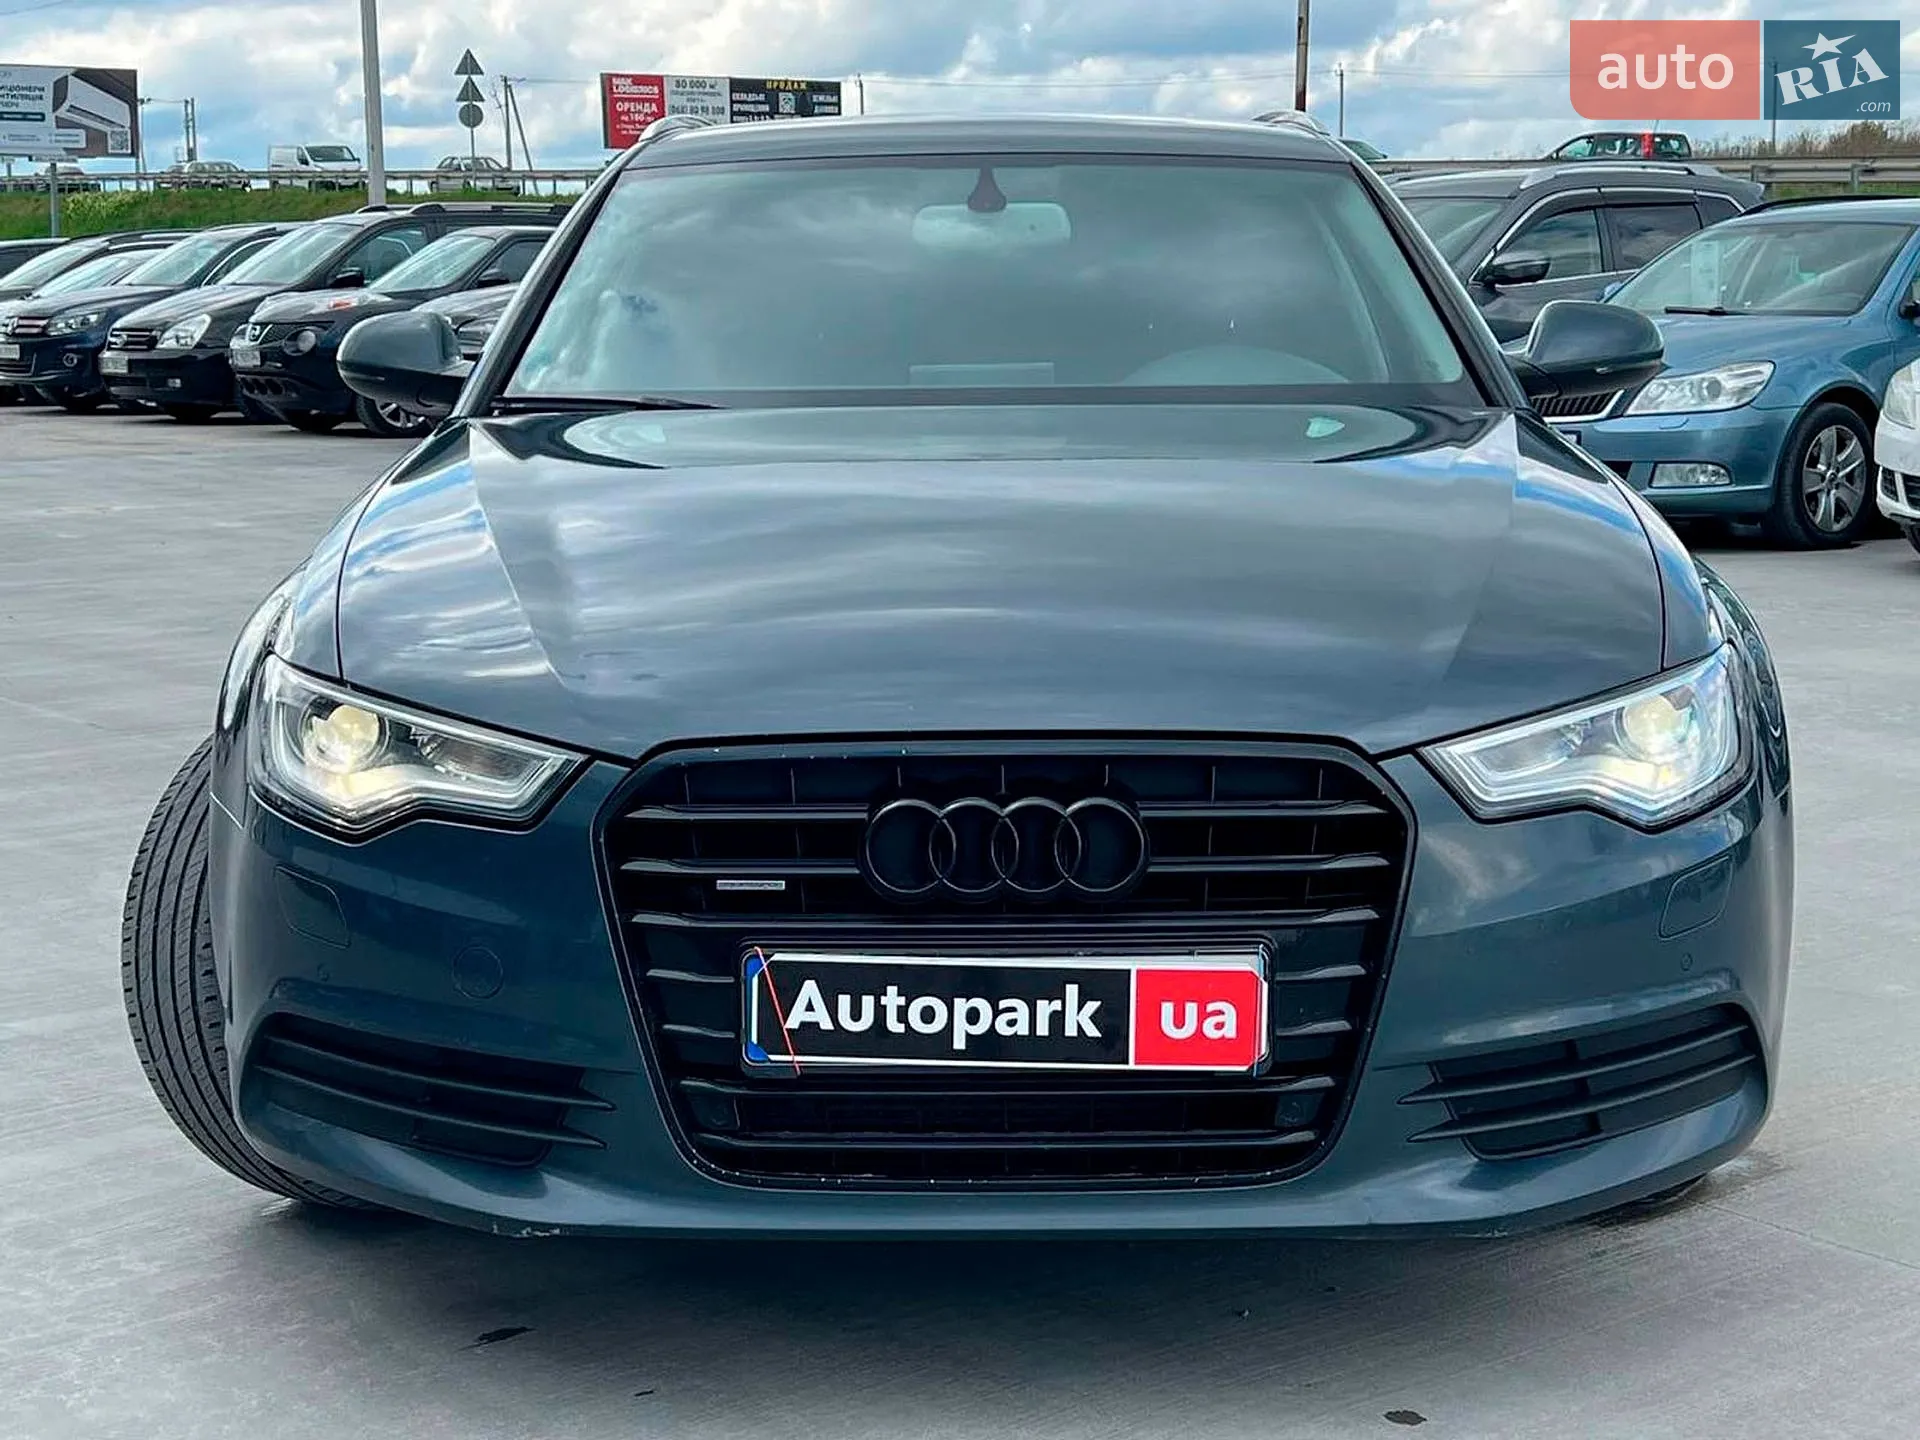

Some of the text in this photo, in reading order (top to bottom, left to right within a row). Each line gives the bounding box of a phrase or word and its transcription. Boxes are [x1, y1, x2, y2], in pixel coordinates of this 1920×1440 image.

[615, 101, 658, 113] ОРЕНДА
[785, 979, 1238, 1049] Autopark ua
